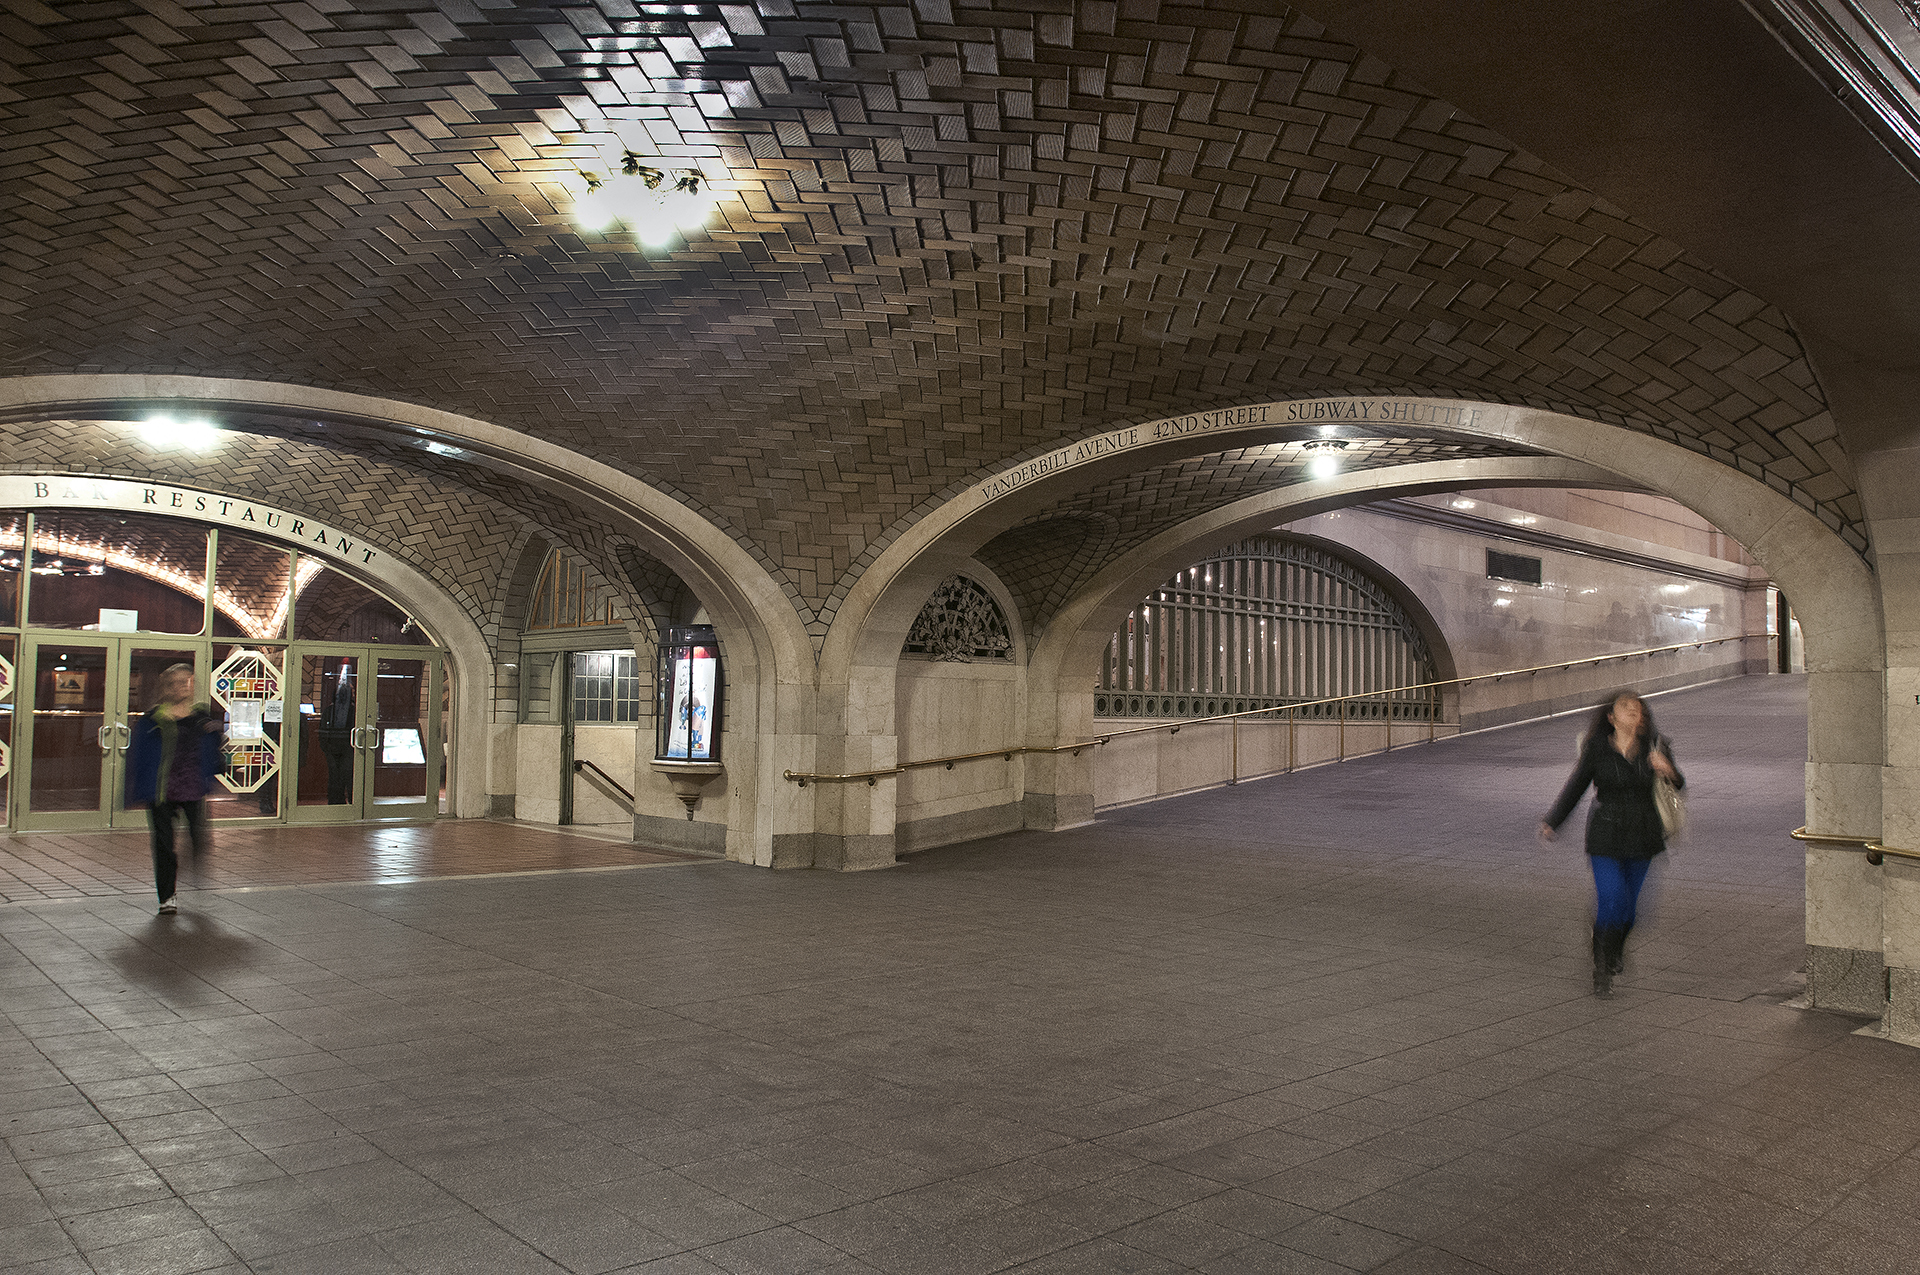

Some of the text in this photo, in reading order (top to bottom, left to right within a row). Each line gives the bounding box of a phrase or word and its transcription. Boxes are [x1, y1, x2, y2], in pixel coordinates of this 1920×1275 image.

[981, 401, 1484, 500] VANDERBILT AVENUE 42ND STREET SUBWAY SHUTTLE
[142, 488, 377, 565] RESTAURANT
[216, 678, 279, 691] OYSTER
[222, 752, 276, 765] YSTER
